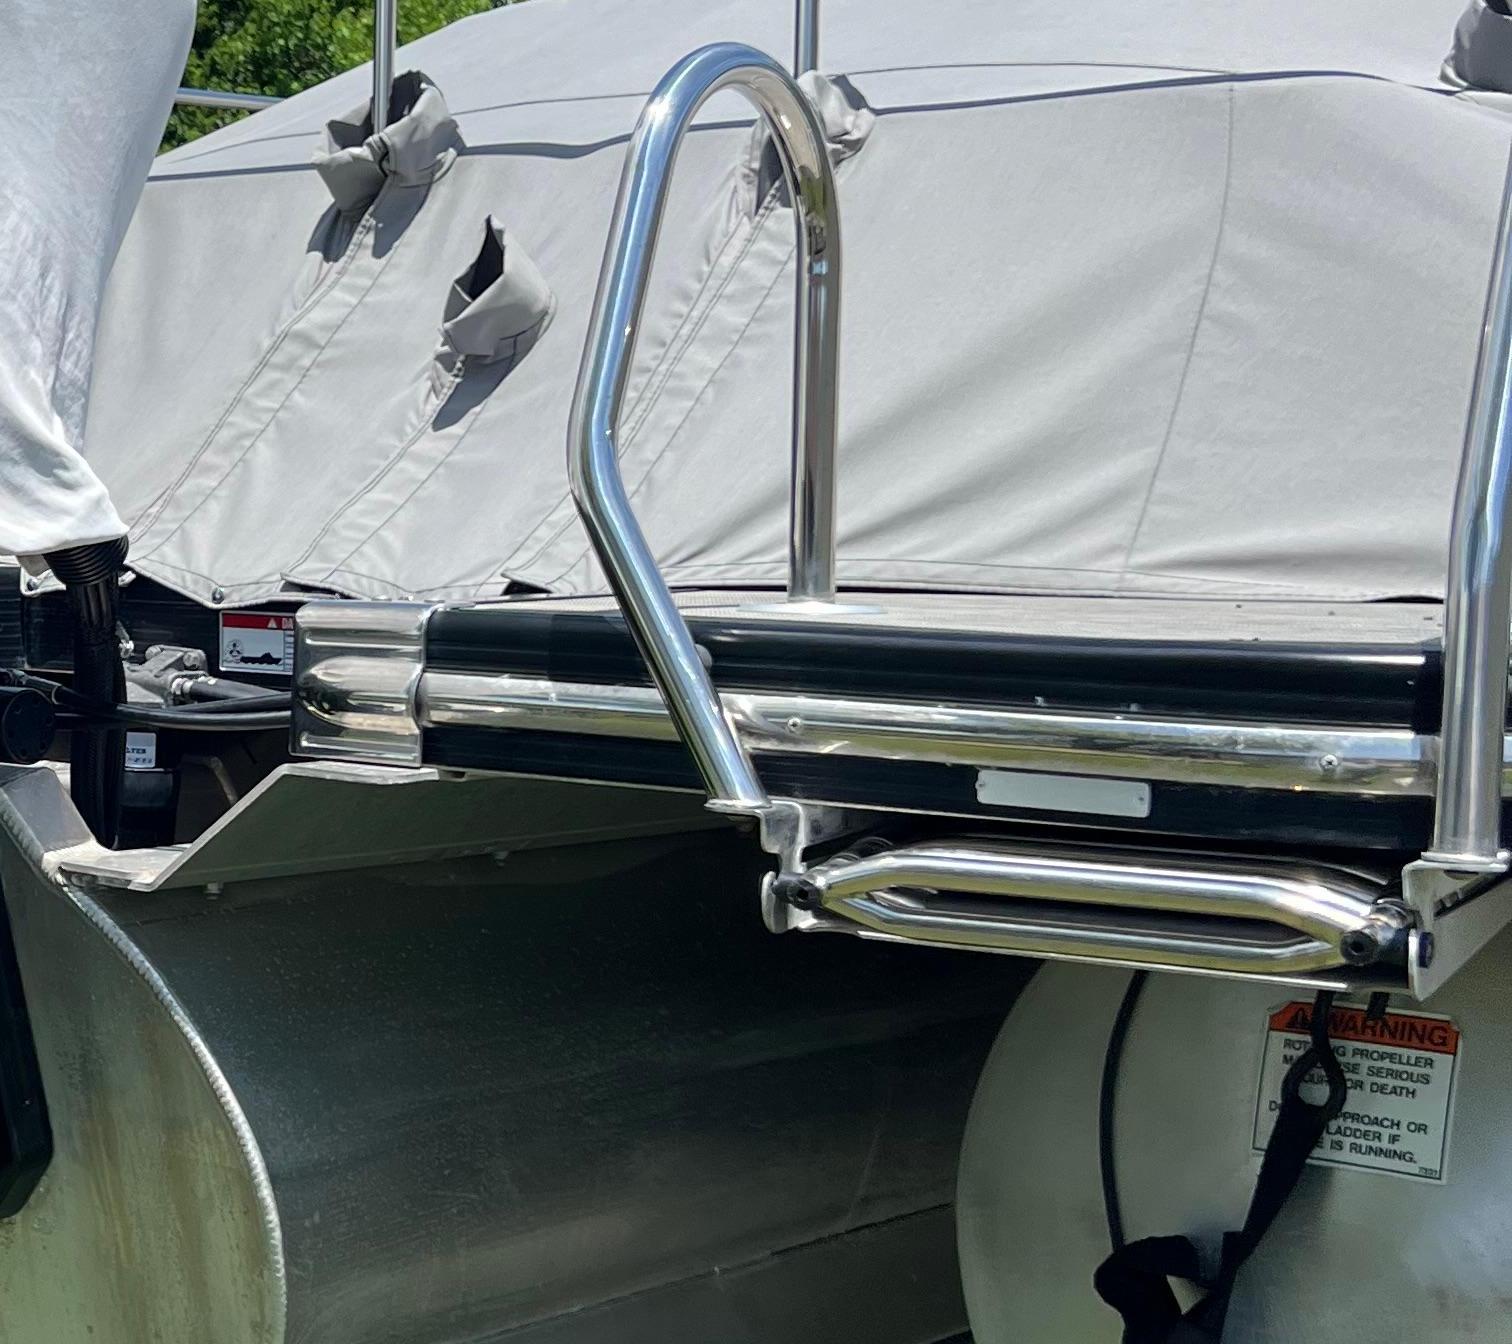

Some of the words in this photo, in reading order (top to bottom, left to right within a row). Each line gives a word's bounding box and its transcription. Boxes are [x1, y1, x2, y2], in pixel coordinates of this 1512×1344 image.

[1329, 1010, 1449, 1047] WARNING
[1352, 1047, 1434, 1069] PROPELLER
[1367, 1065, 1431, 1085] SERIOUS
[1370, 1081, 1417, 1099] DEATH
[1326, 1126, 1382, 1143] LADDER
[1388, 1134, 1401, 1145] IF
[1407, 1121, 1429, 1135] OR
[1330, 1139, 1344, 1151] IS
[1349, 1142, 1418, 1163] RUNNING.
